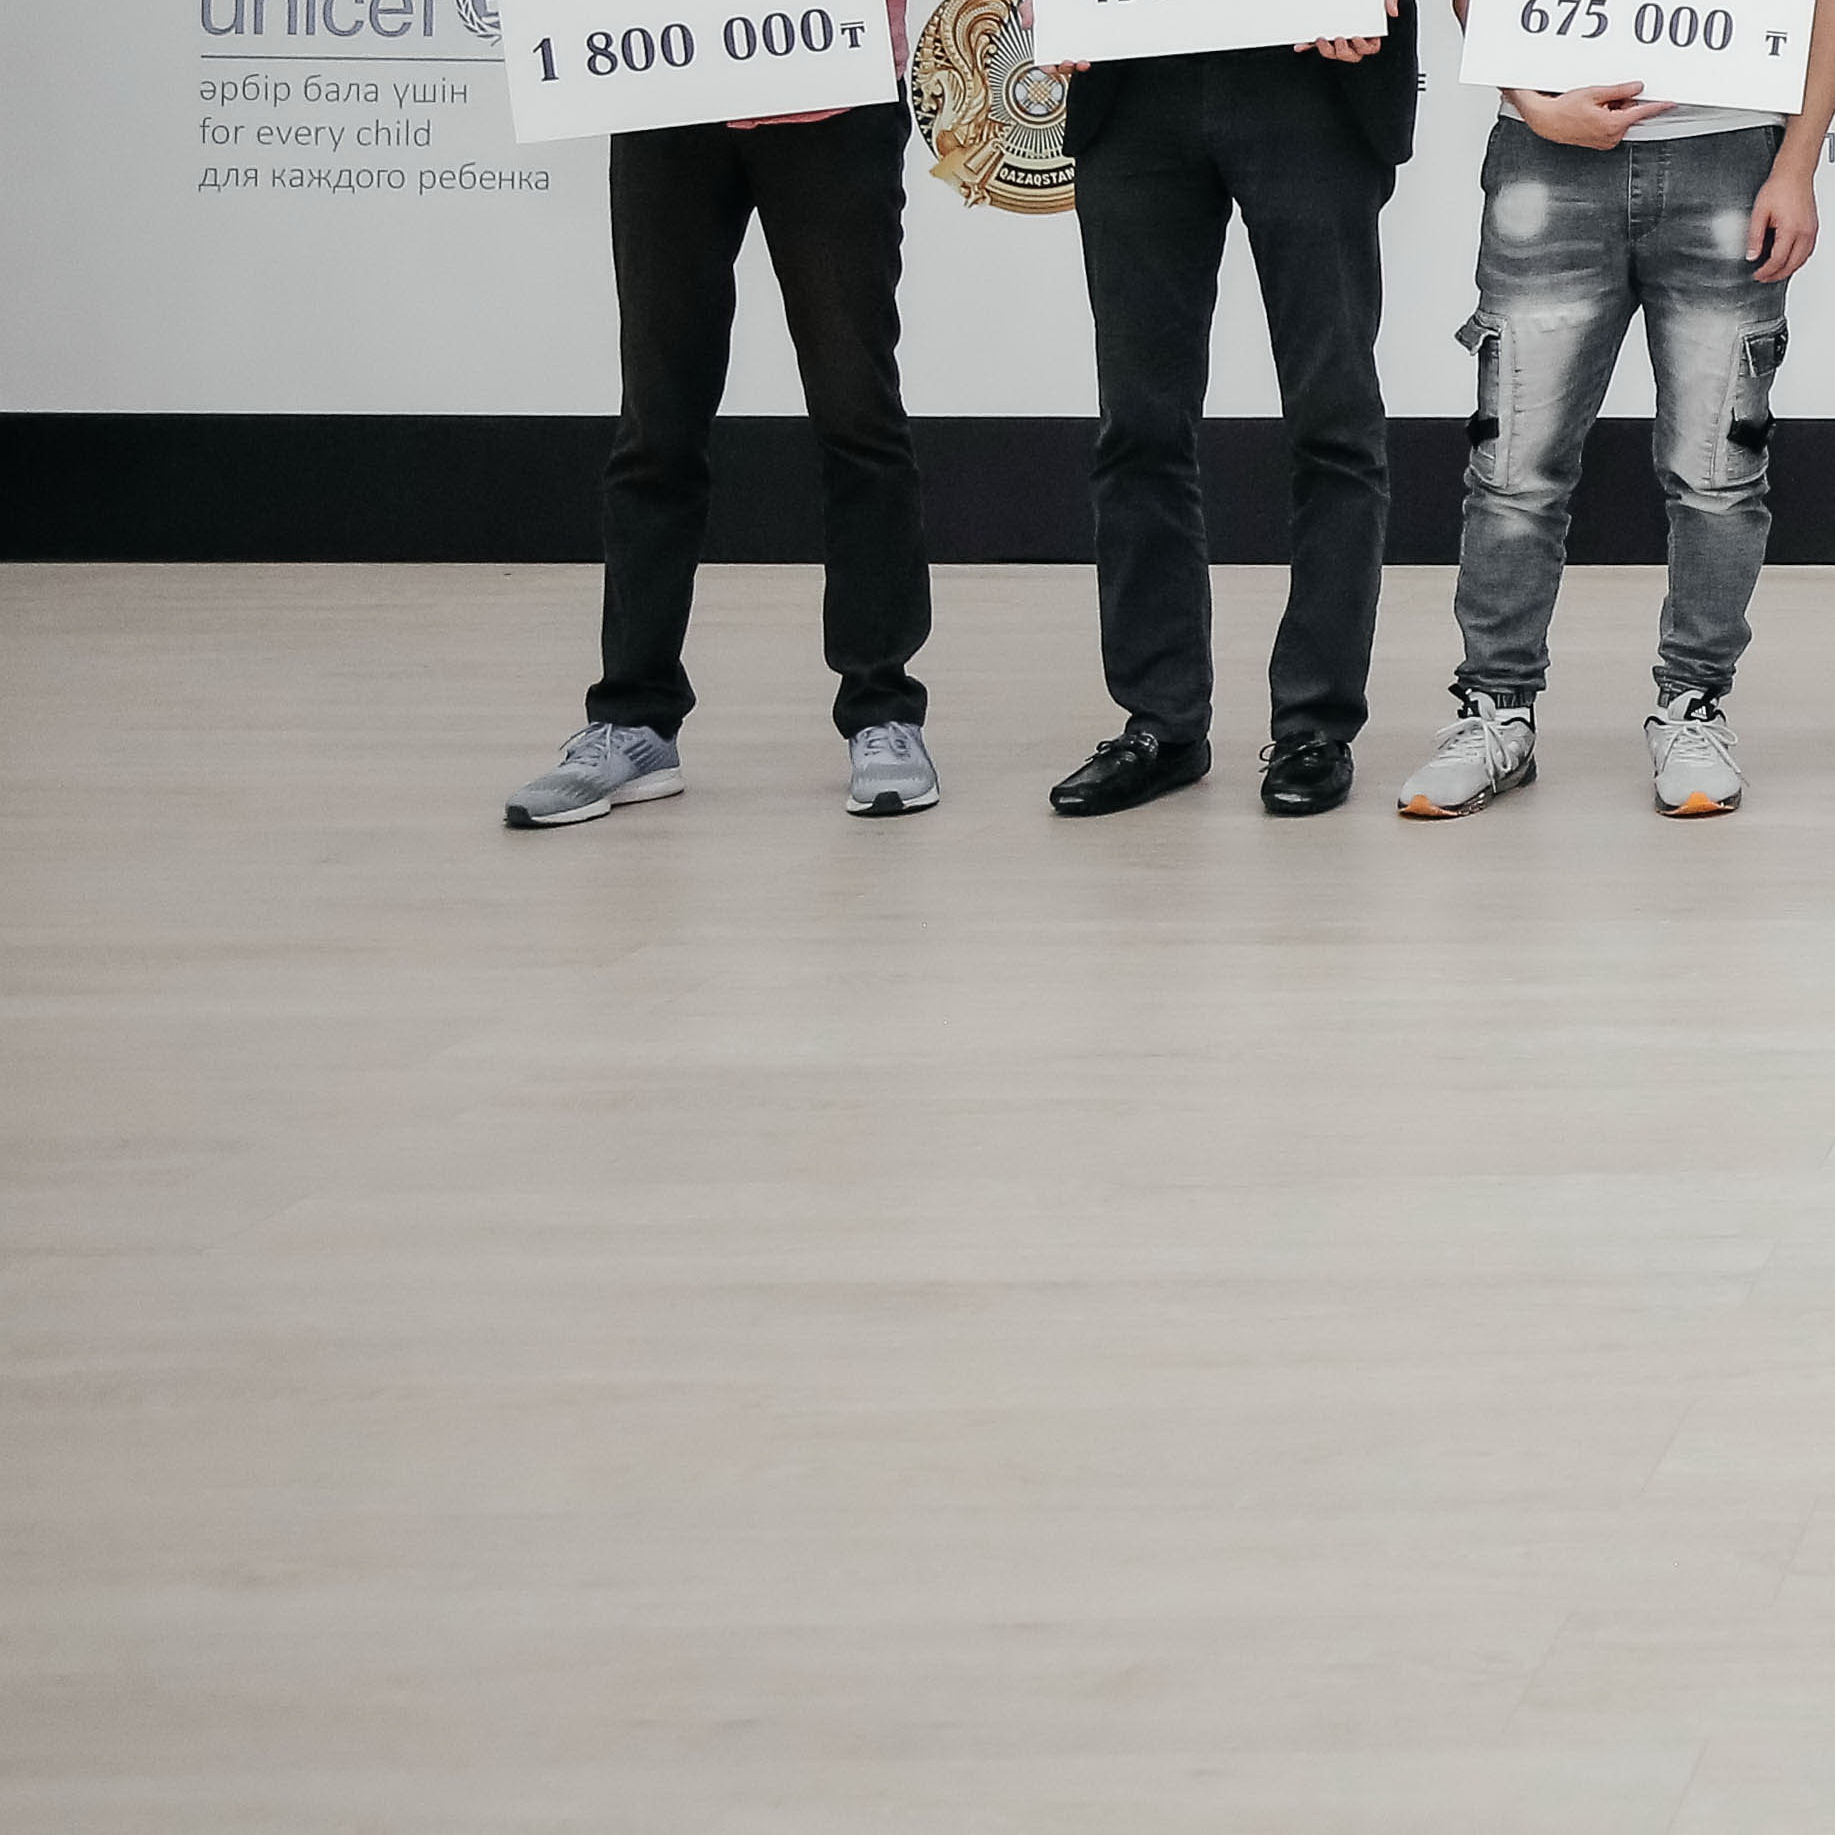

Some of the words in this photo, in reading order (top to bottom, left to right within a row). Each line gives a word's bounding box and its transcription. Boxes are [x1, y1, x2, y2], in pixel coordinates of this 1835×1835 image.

[532, 37, 559, 82] 1
[586, 23, 694, 76] 800
[723, 8, 833, 61] 000
[1634, 3, 1733, 51] 000
[199, 73, 291, 107] әрбір
[303, 73, 379, 103] бала
[199, 116, 246, 145] for
[256, 125, 345, 153] every
[356, 118, 431, 147] child
[198, 166, 259, 193] для
[271, 167, 406, 195] каждого
[419, 161, 550, 196] ребенка
